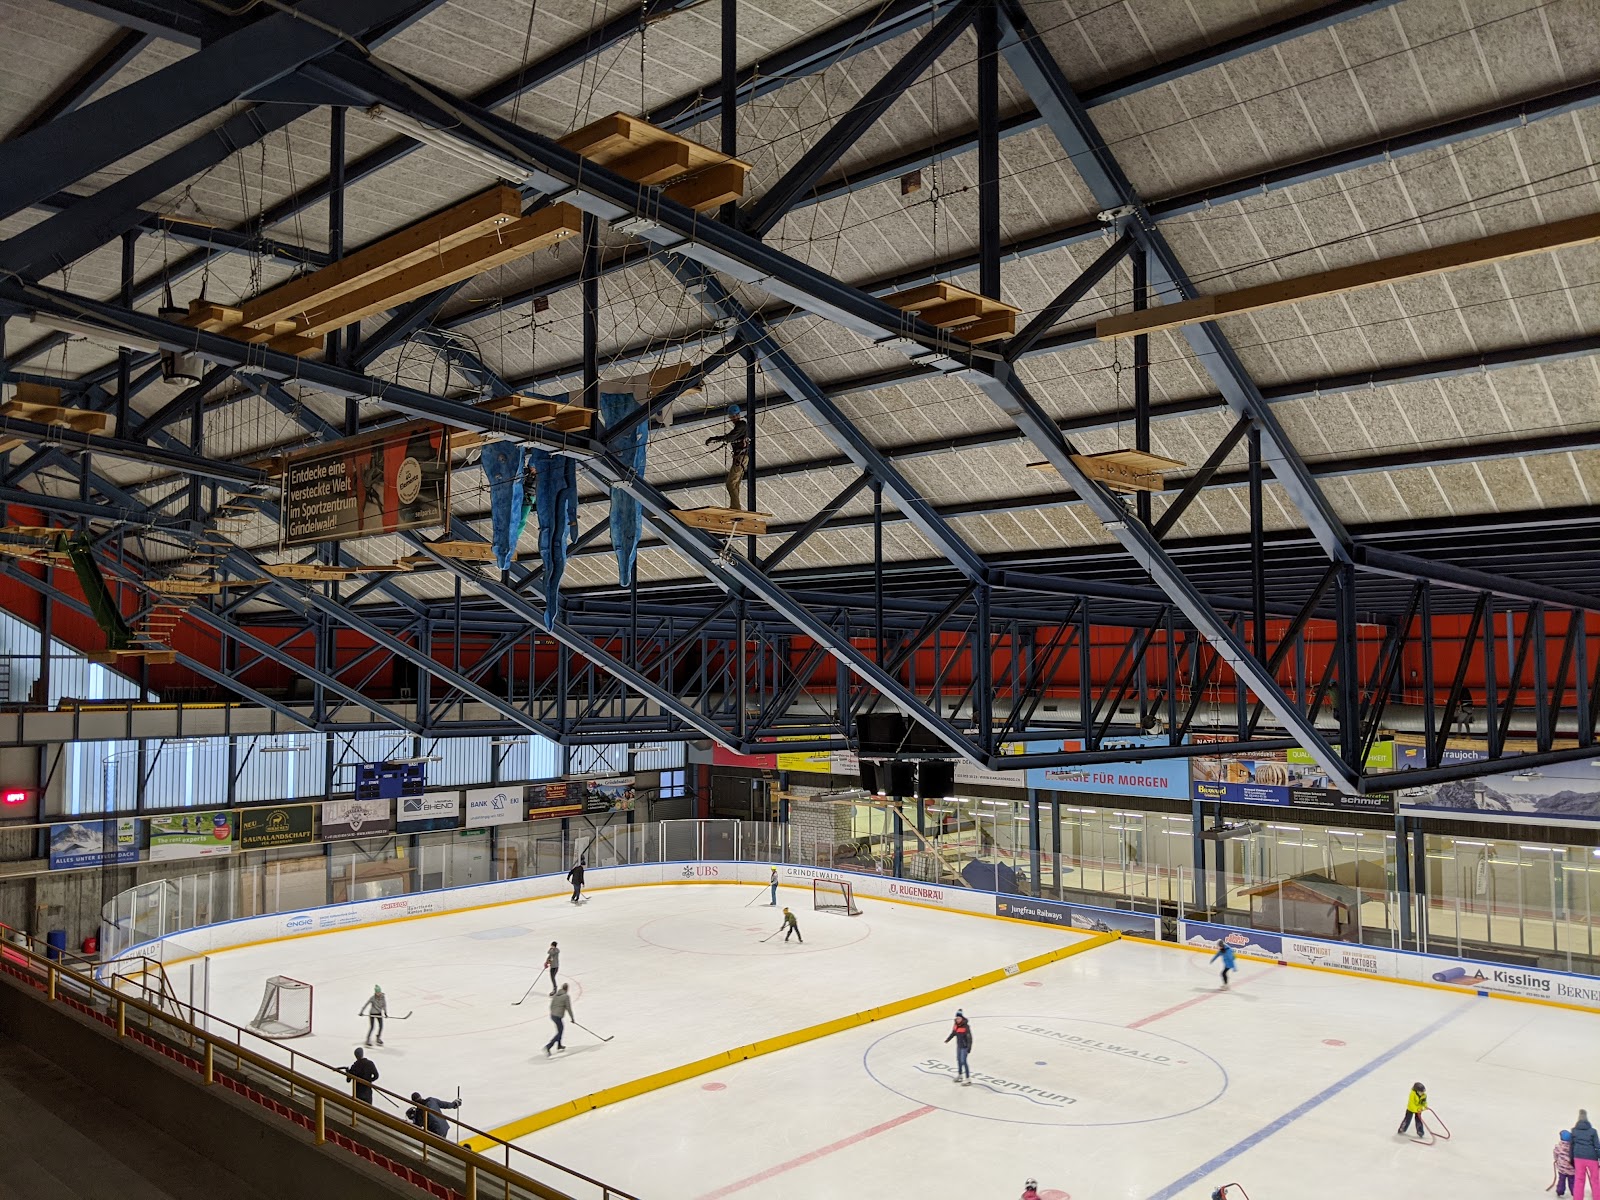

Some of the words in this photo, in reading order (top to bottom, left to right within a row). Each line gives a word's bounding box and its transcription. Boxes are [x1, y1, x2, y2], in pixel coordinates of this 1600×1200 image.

[291, 464, 327, 485] Entdecke
[328, 461, 346, 475] eine
[290, 482, 331, 502] versteckte
[332, 477, 352, 494] Welt
[290, 505, 301, 518] im
[301, 496, 357, 520] Sportzentrum
[289, 516, 338, 537] Grindelwald!
[1422, 748, 1479, 761] Jfraujoch
[1093, 771, 1115, 785] FÜR
[1118, 775, 1168, 788] MORGEN
[1340, 796, 1382, 806] schmid
[243, 821, 257, 829] NEU
[182, 836, 207, 844] experts
[243, 831, 311, 843] SAUNALANDSCHAFT
[696, 866, 718, 876] UBS
[787, 868, 839, 880] GRINDELWALD
[1011, 905, 1034, 916] Jungfrau
[1036, 908, 1063, 920] Railways
[1293, 943, 1331, 956] COUNTRYNIGHT
[1342, 956, 1350, 964] IM
[1351, 957, 1378, 968] OKTOBER
[1473, 969, 1489, 980] A.
[1493, 970, 1551, 991] Kissling
[1016, 1024, 1172, 1064] GRINDELWALD
[920, 1059, 1078, 1105] Spotzentrum
